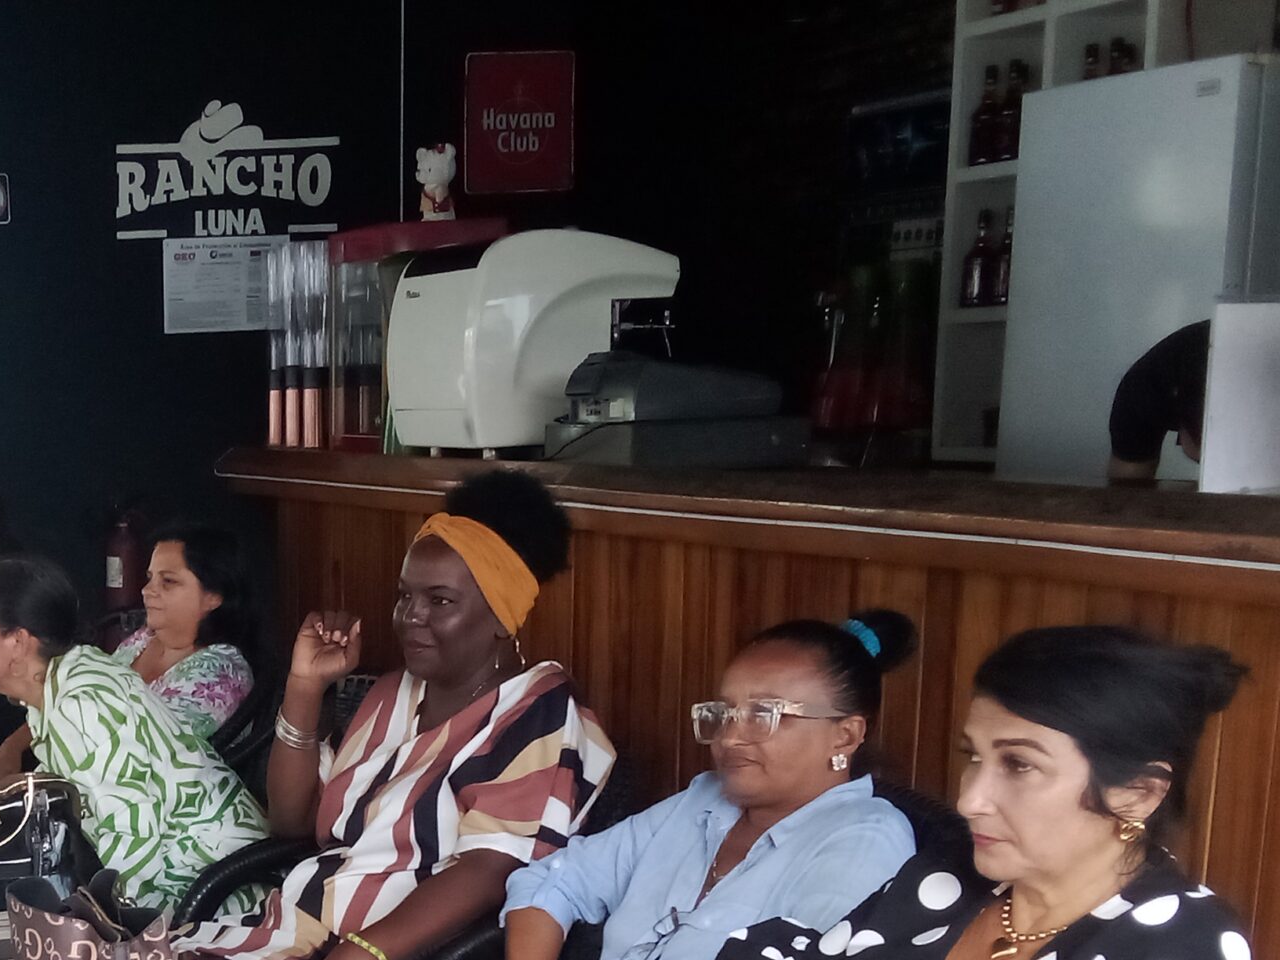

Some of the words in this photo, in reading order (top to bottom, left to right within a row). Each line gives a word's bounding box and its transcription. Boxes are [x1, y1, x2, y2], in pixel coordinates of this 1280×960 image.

[482, 107, 556, 130] Havana
[497, 131, 539, 152] Club
[115, 153, 332, 219] RANCHO
[195, 208, 266, 236] LUNA
